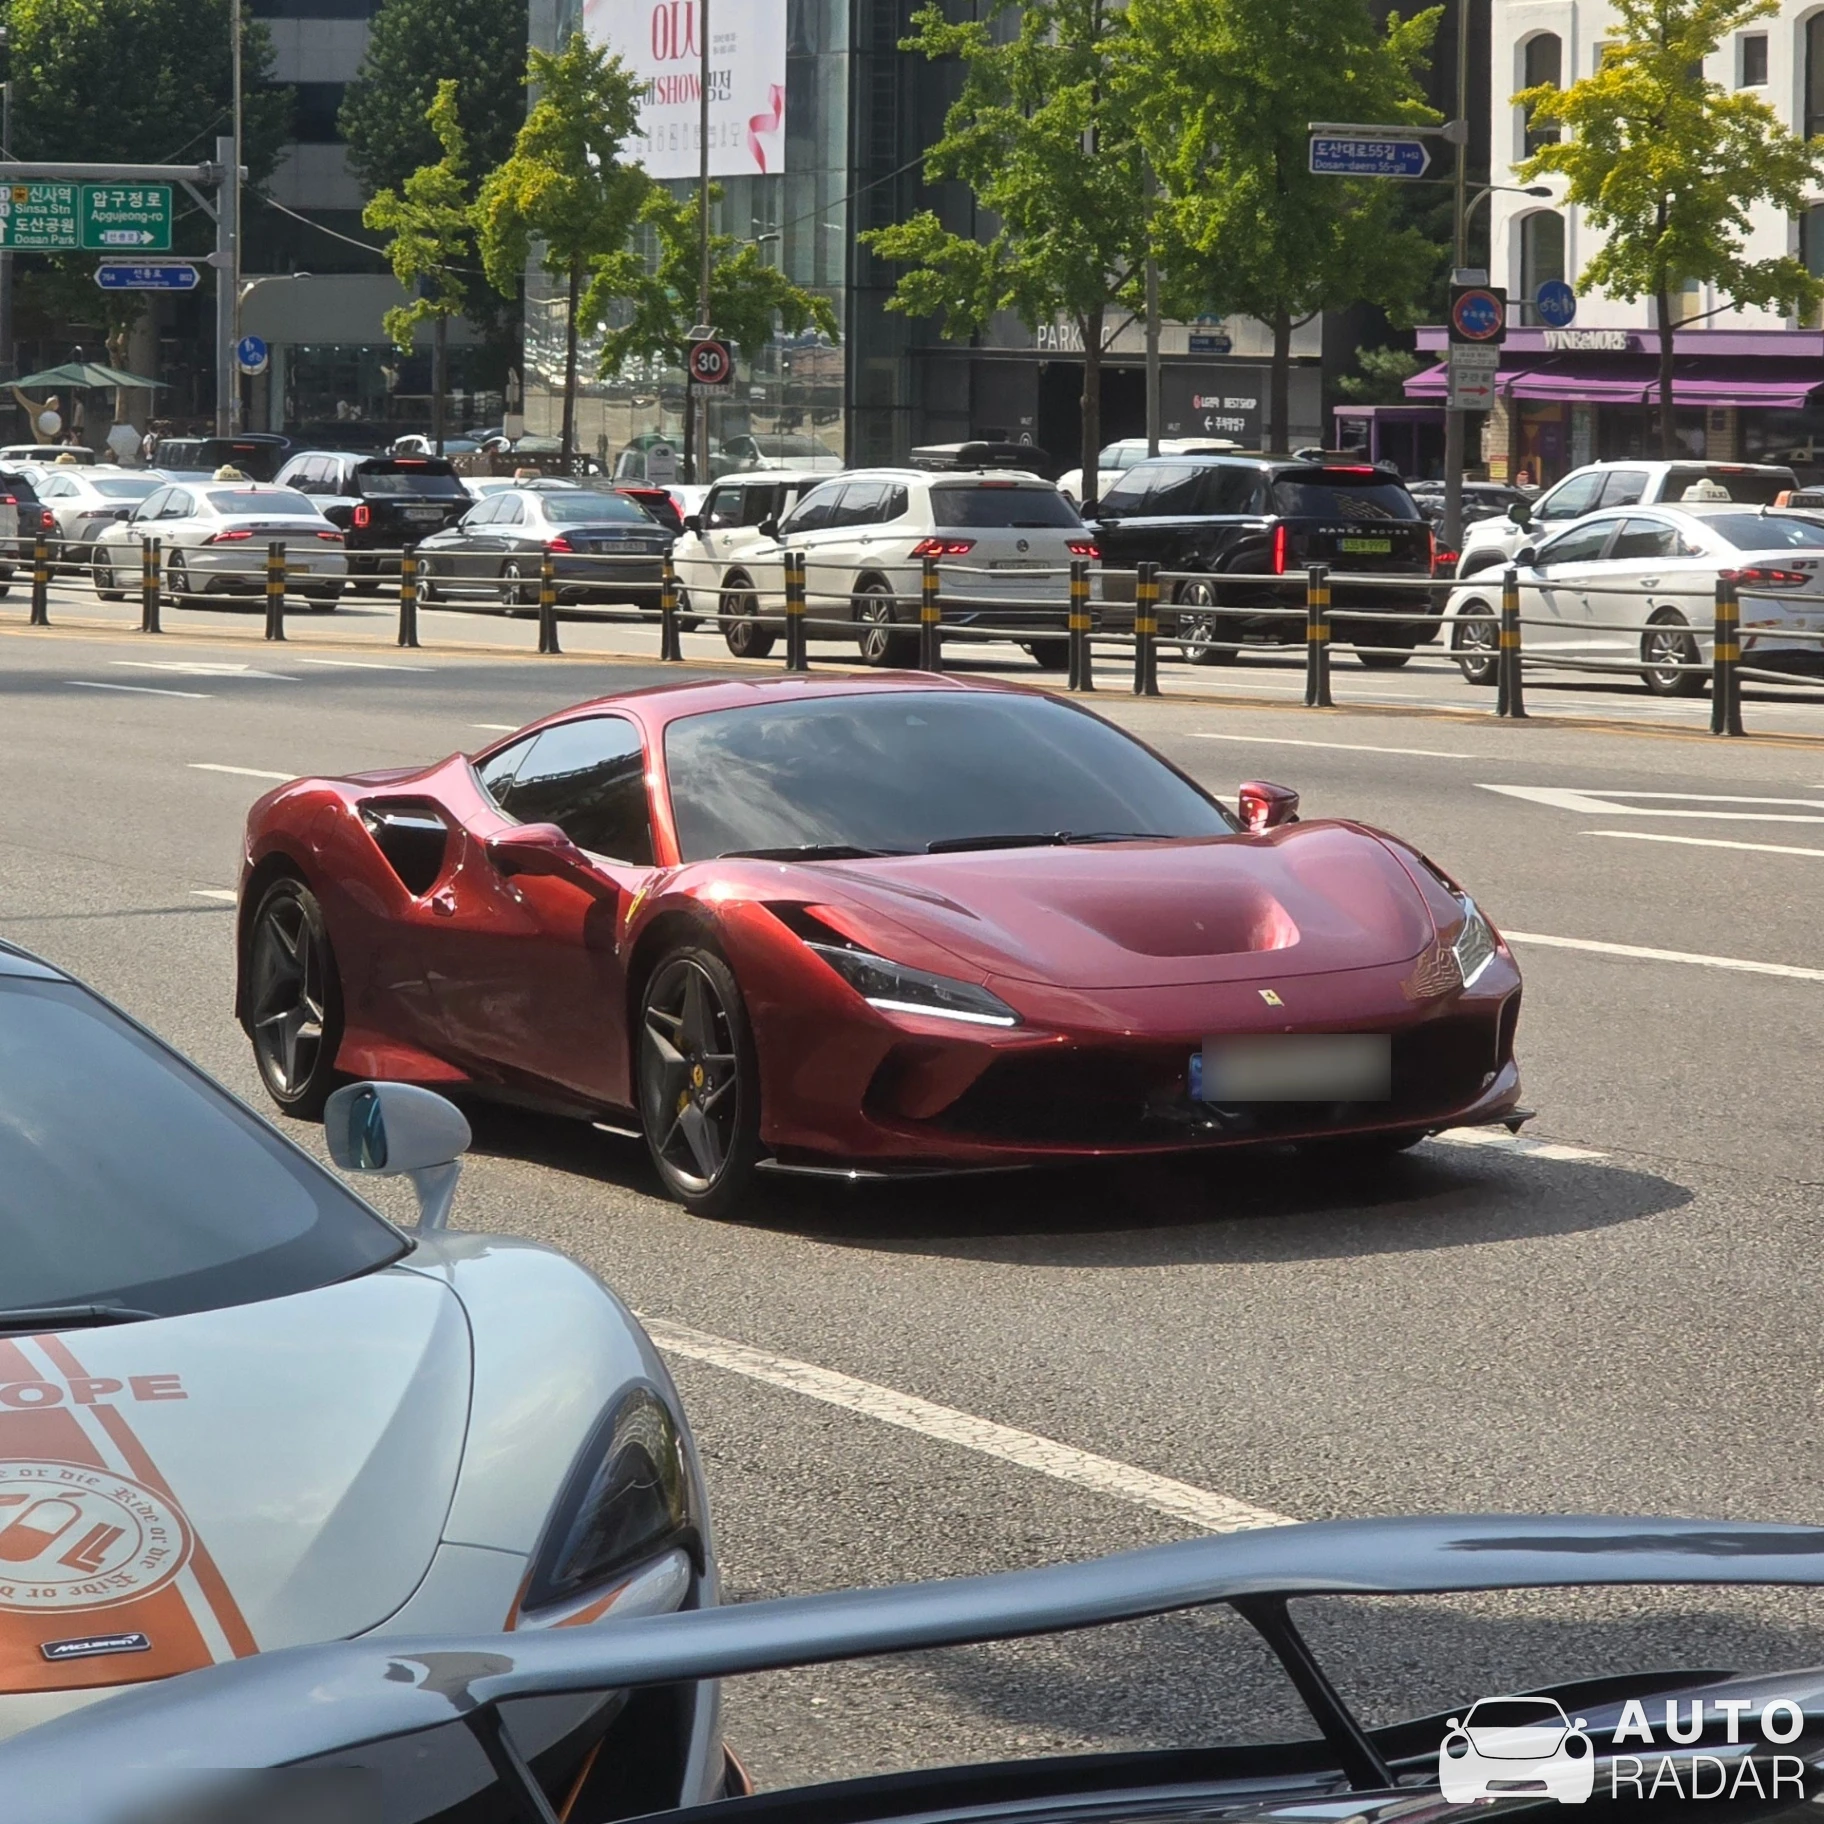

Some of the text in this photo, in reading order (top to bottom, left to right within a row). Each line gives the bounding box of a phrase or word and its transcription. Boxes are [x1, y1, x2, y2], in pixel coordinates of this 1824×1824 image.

[1315, 142, 1396, 160] 도산대로55길
[1315, 159, 1406, 173] Dosan-daero 55-gil
[29, 186, 71, 204] 신사역
[92, 191, 163, 208] 압구정로
[14, 203, 71, 214] Sinsa Stn
[91, 210, 164, 223] Apgujeong-ro
[14, 218, 74, 233] 도산공원
[14, 234, 75, 245] Dosan Park
[1037, 325, 1112, 352] PARKG
[697, 352, 720, 371] 30
[1706, 491, 1727, 499] TAXI
